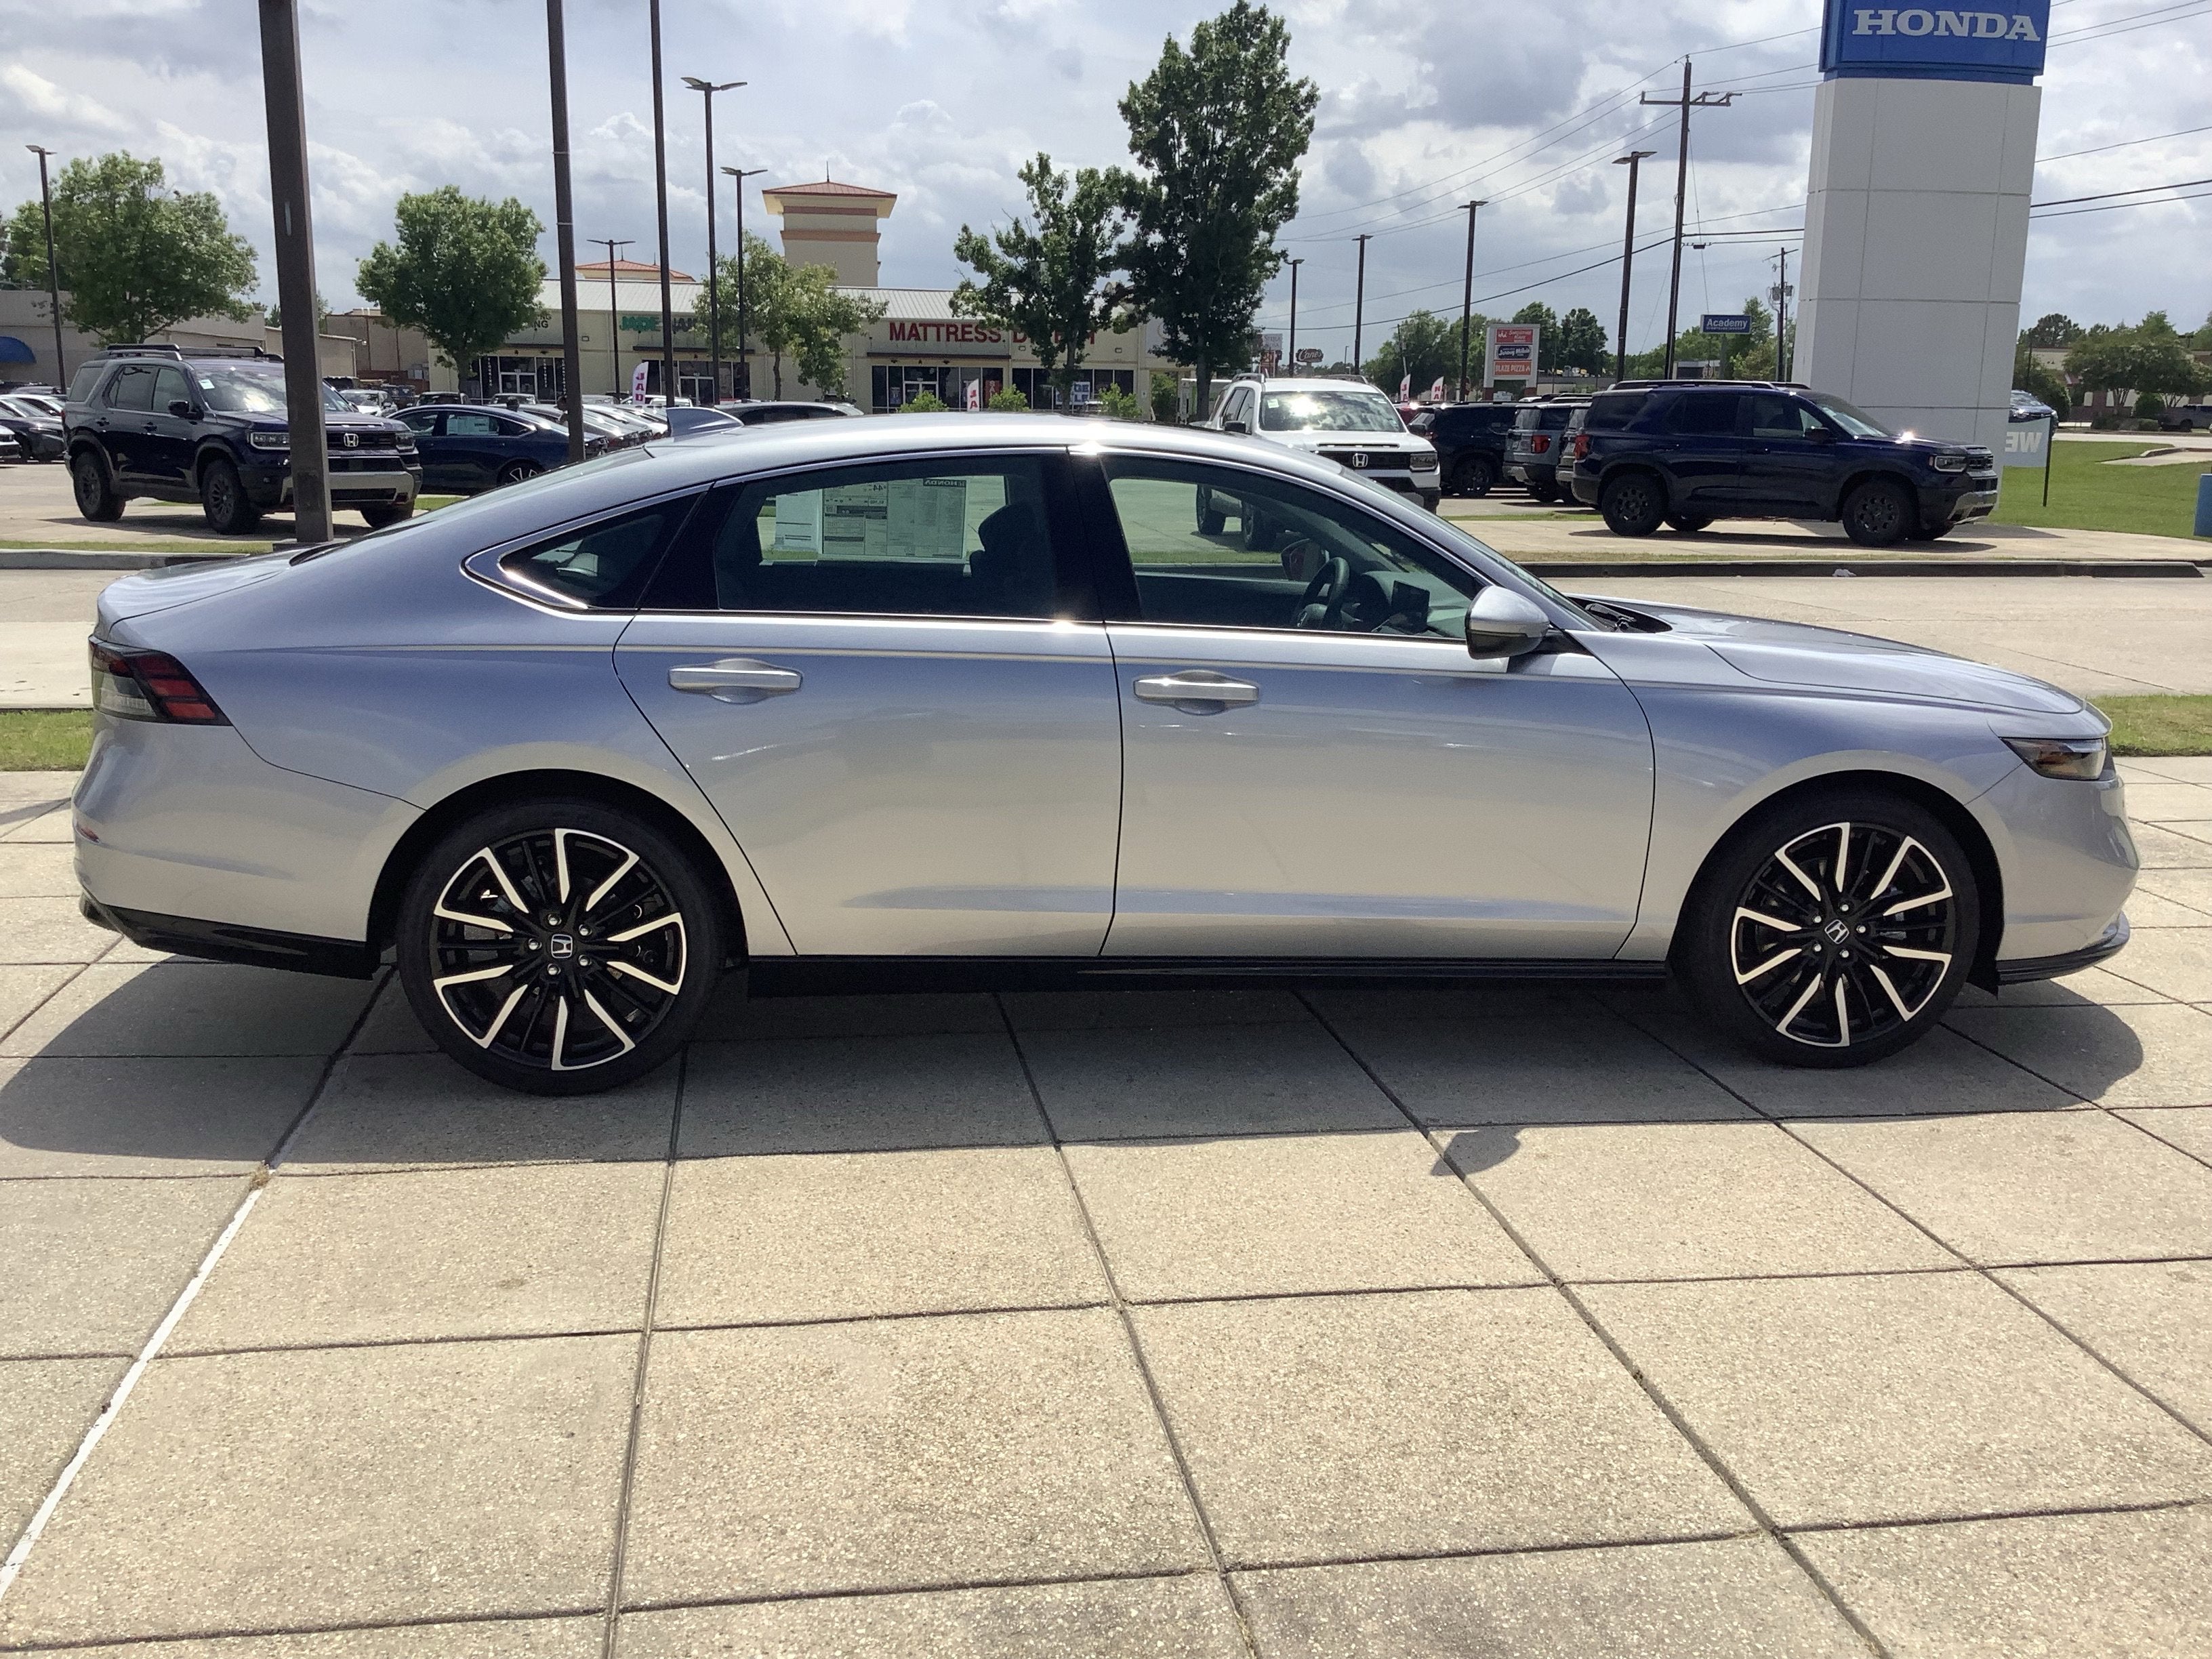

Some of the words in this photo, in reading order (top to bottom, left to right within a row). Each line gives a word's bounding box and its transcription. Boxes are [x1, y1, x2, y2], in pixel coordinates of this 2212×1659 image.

[1852, 9, 2041, 41] HONDA
[889, 322, 1002, 343] MATTRESS
[1706, 319, 1748, 329] Academy
